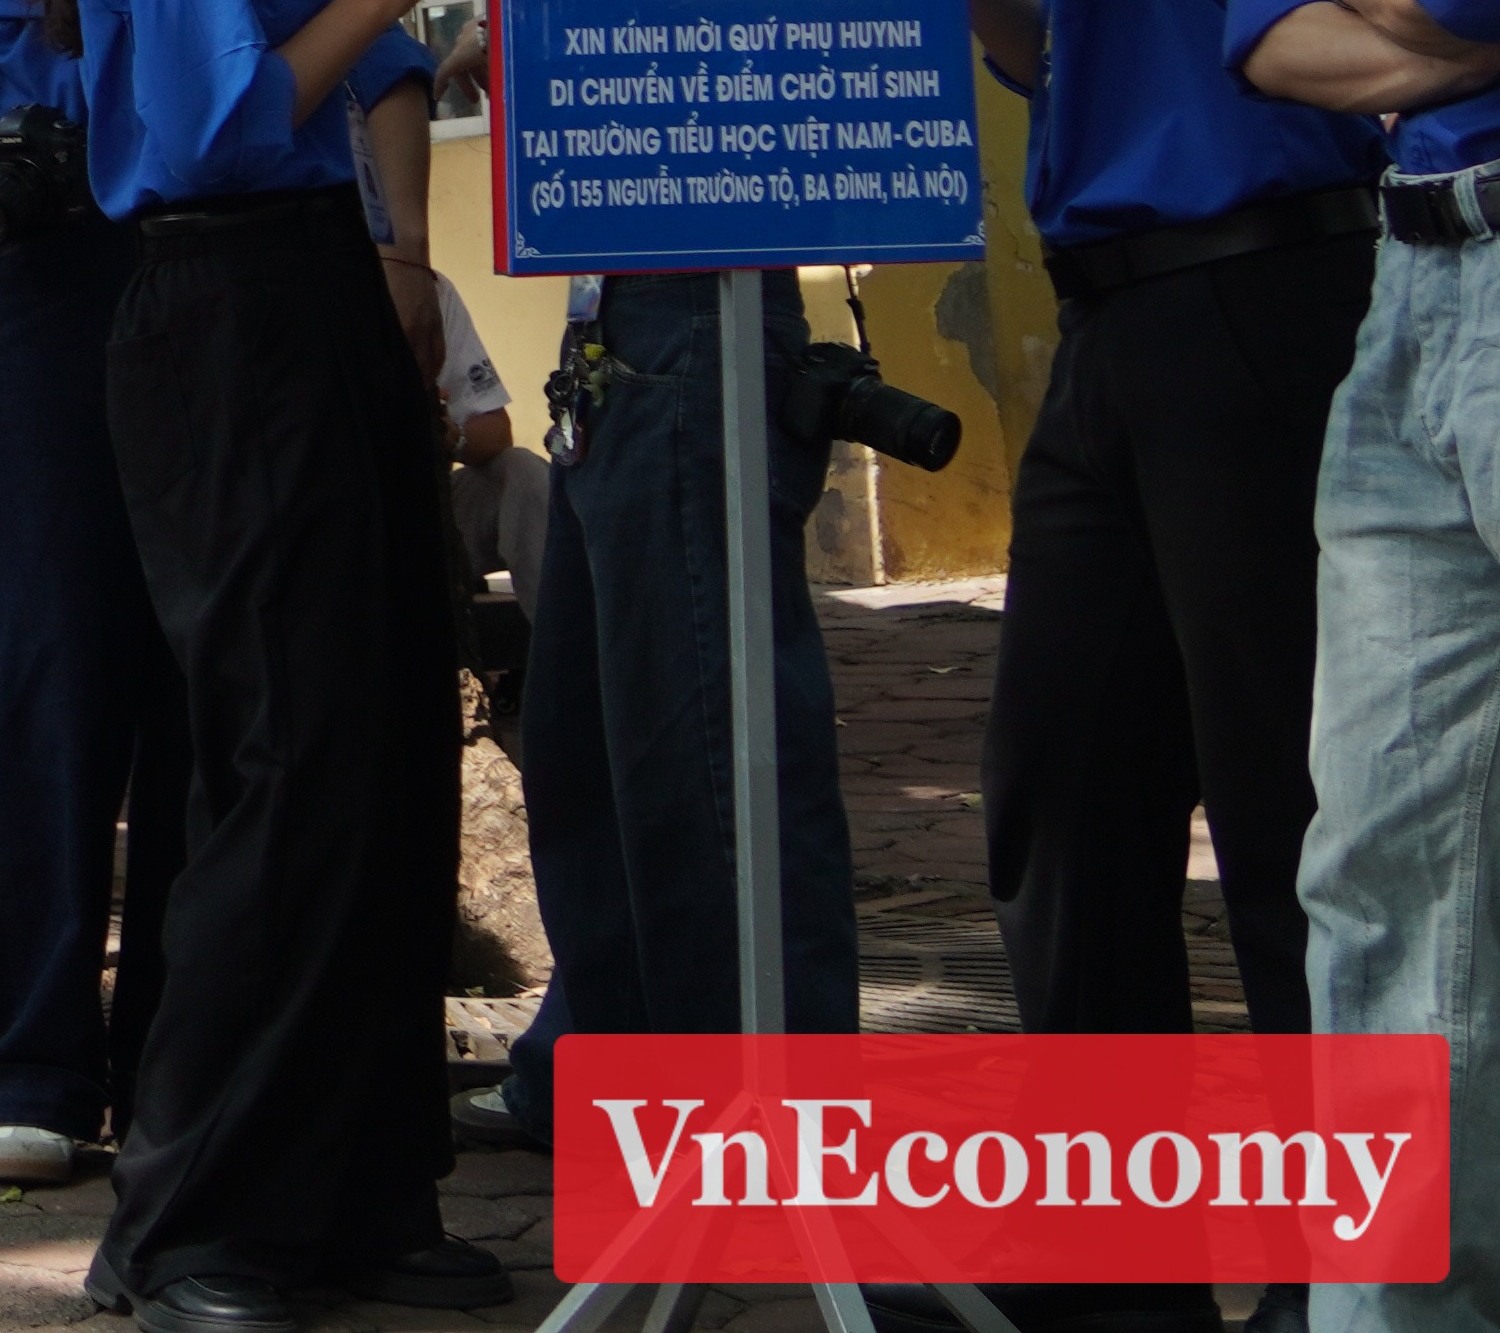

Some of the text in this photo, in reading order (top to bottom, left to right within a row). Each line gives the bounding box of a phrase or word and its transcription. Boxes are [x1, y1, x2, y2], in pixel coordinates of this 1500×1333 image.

[565, 16, 921, 57] XIN KÍNH MỜI QUÝ PHỤ HUYNH
[550, 60, 939, 106] DI CHUYỂN VỀ ĐIỂM CHỜ THÍ SINH
[523, 130, 558, 165] TẠI
[565, 121, 661, 157] TRƯỜNG
[668, 112, 713, 154] TIỂU
[721, 123, 776, 160] HỌC
[782, 115, 830, 158] VIỆT
[532, 162, 968, 215] (SỐ 155 NGUYỄN TRƯỜNG TỘ, BA ĐÌNH, HÀ NỘI)
